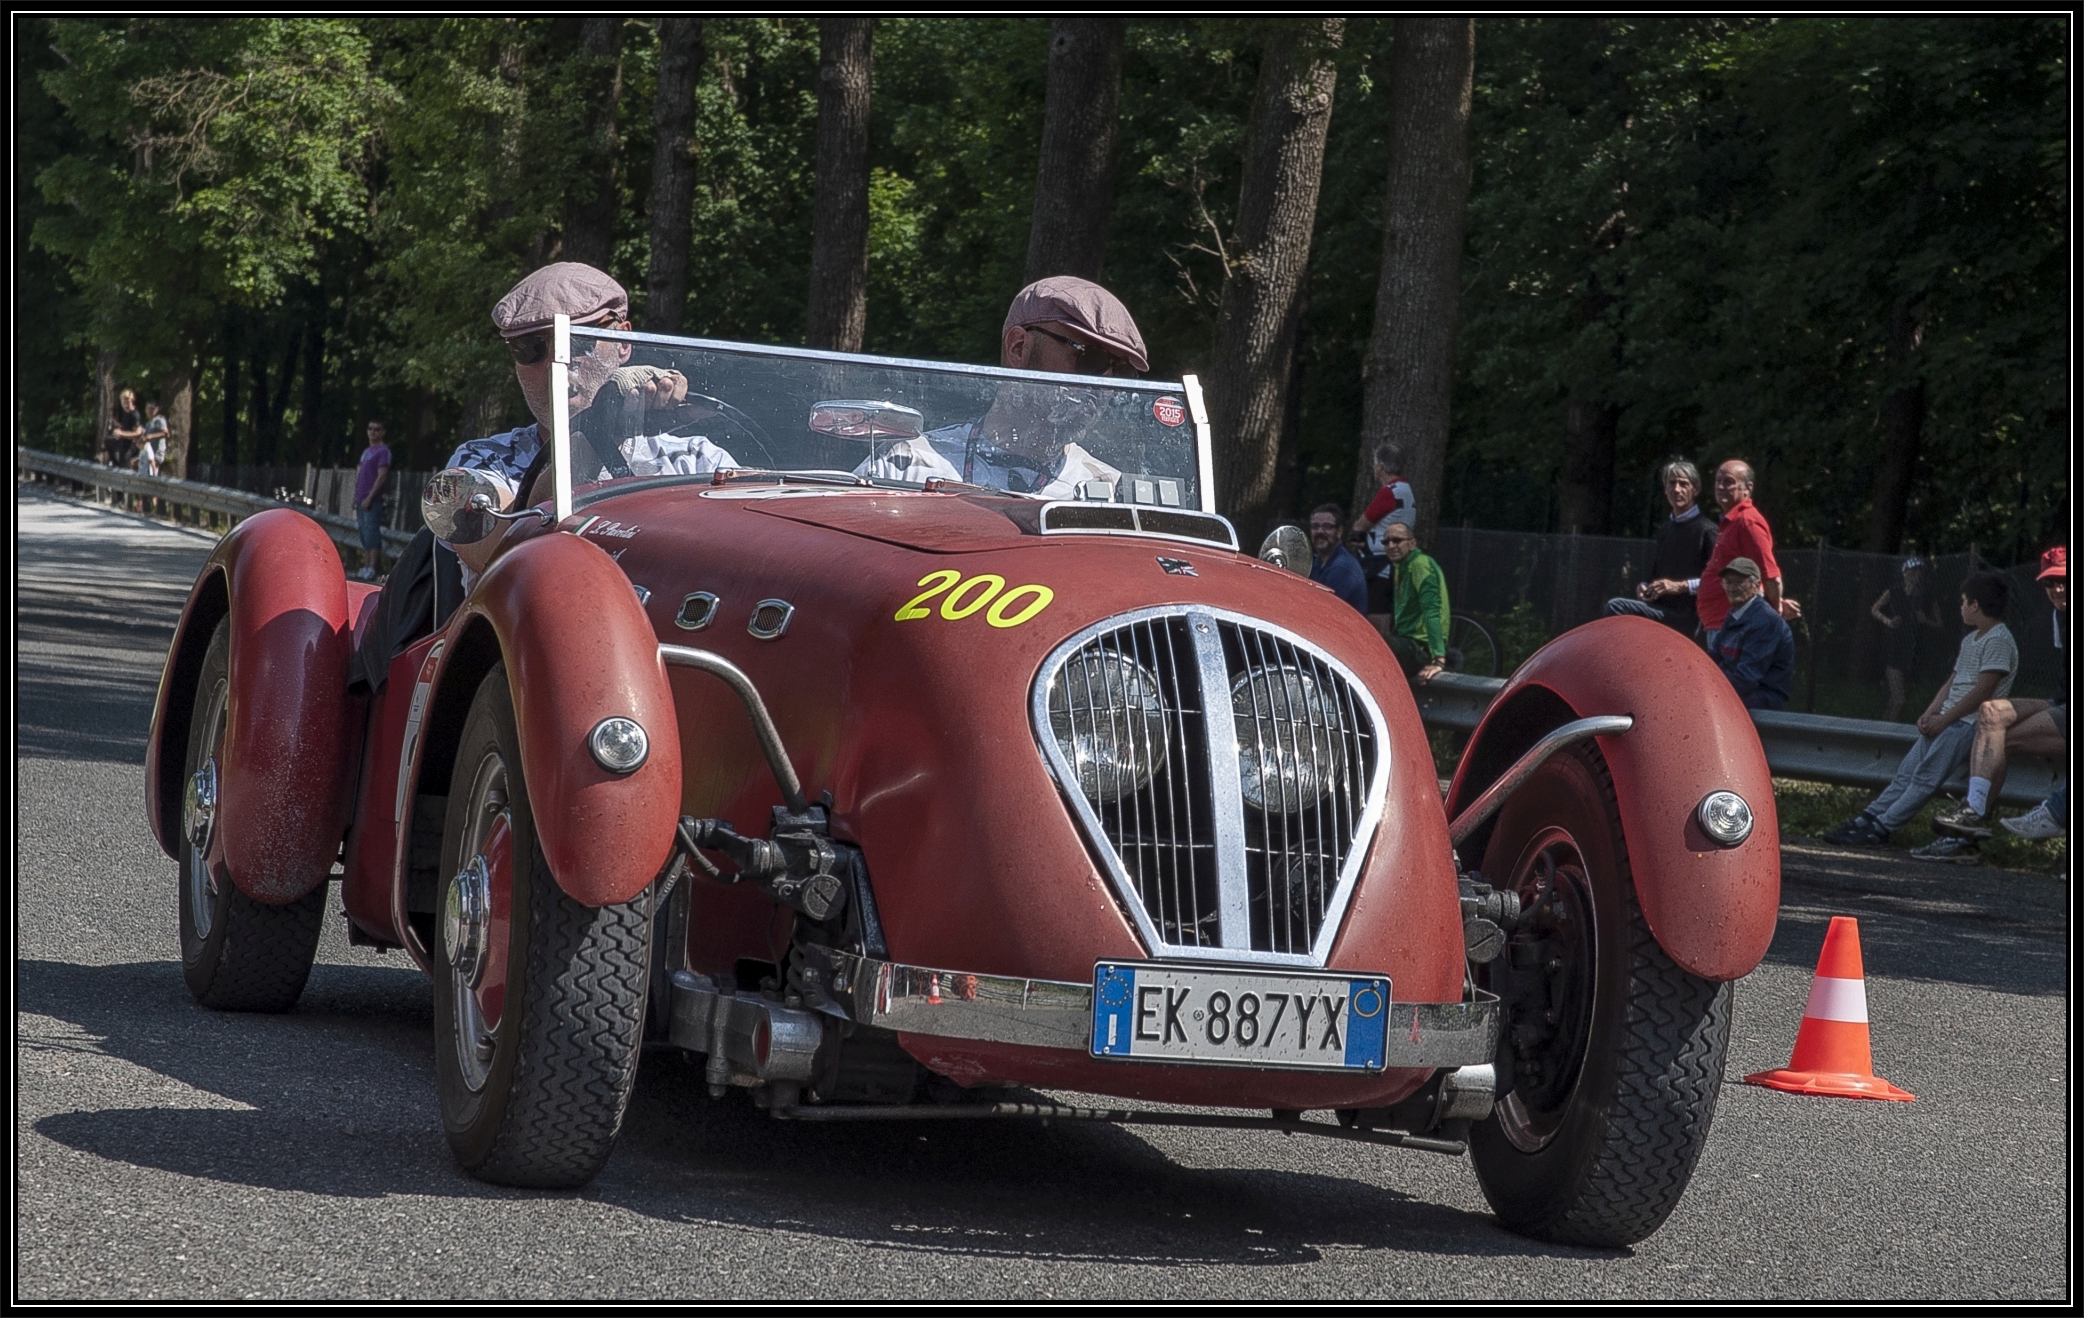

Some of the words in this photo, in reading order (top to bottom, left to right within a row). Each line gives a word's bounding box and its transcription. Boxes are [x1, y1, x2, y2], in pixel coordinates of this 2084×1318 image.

[1159, 406, 1181, 418] 2015
[894, 569, 1054, 628] 200
[1135, 985, 1191, 1044] EK
[1206, 990, 1346, 1051] 887YX
